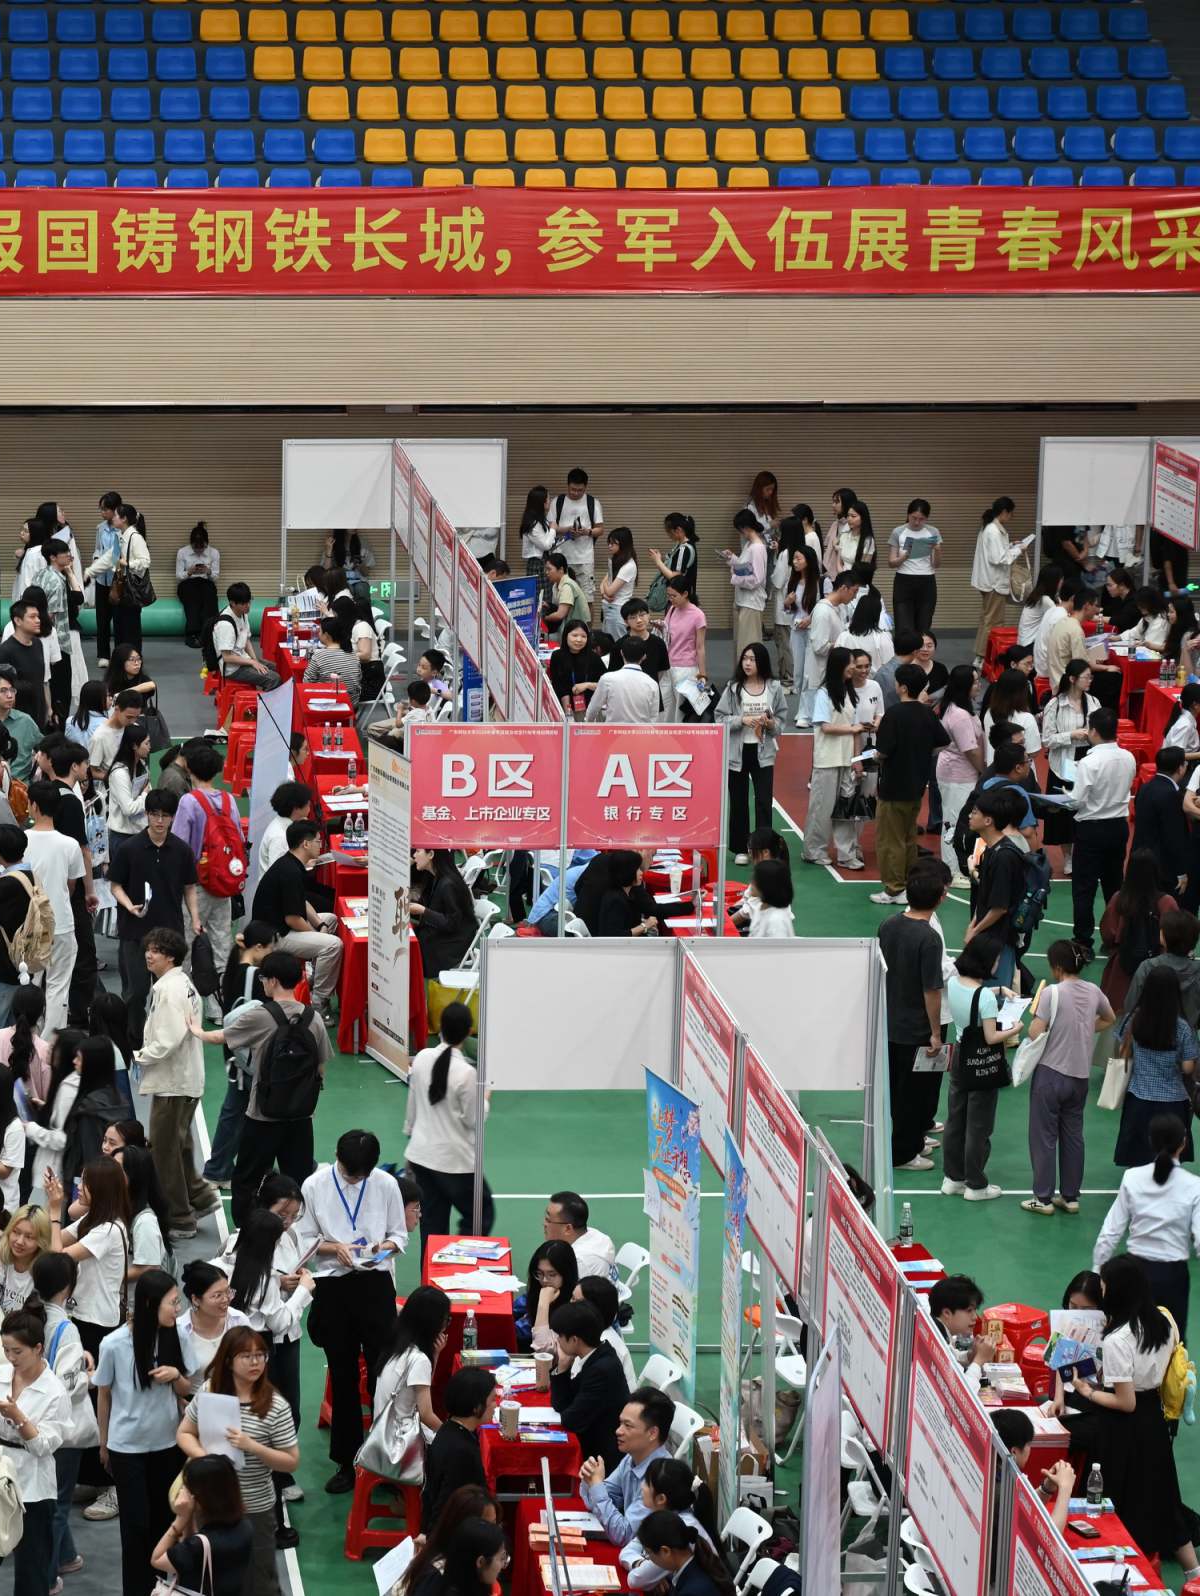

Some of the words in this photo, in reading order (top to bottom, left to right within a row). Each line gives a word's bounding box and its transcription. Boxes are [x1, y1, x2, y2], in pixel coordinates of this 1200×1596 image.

[441, 754, 534, 798] B区
[597, 754, 693, 798] A区
[422, 806, 551, 822] 基金、上市企业专区
[604, 806, 688, 821] 银行专区
